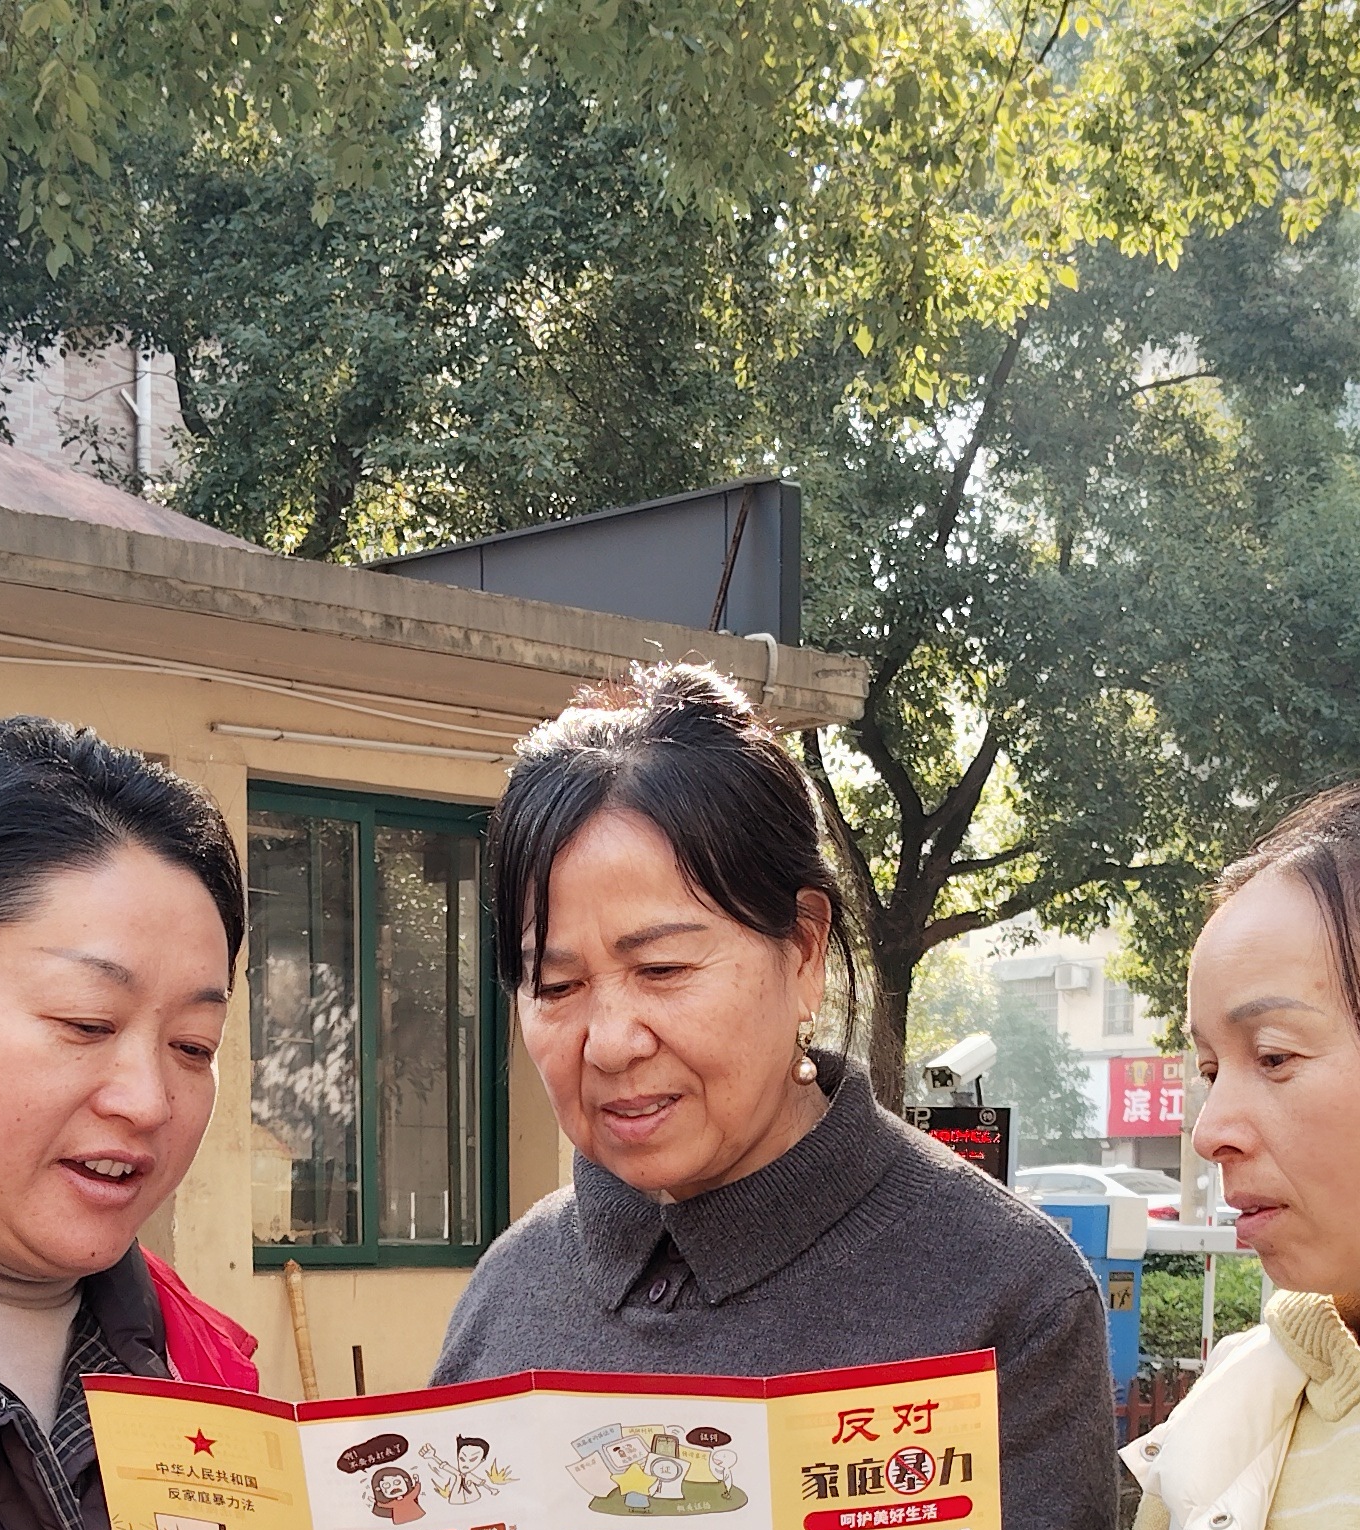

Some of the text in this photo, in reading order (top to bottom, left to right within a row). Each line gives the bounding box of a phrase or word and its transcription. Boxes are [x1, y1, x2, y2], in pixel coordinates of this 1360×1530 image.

[832, 1399, 939, 1444] 反对
[155, 1461, 259, 1489] 中华人民共和国
[801, 1446, 973, 1500] 家庭暴力
[168, 1487, 256, 1513] 反家庭暴力法
[839, 1503, 938, 1529] 呵护美好生活
